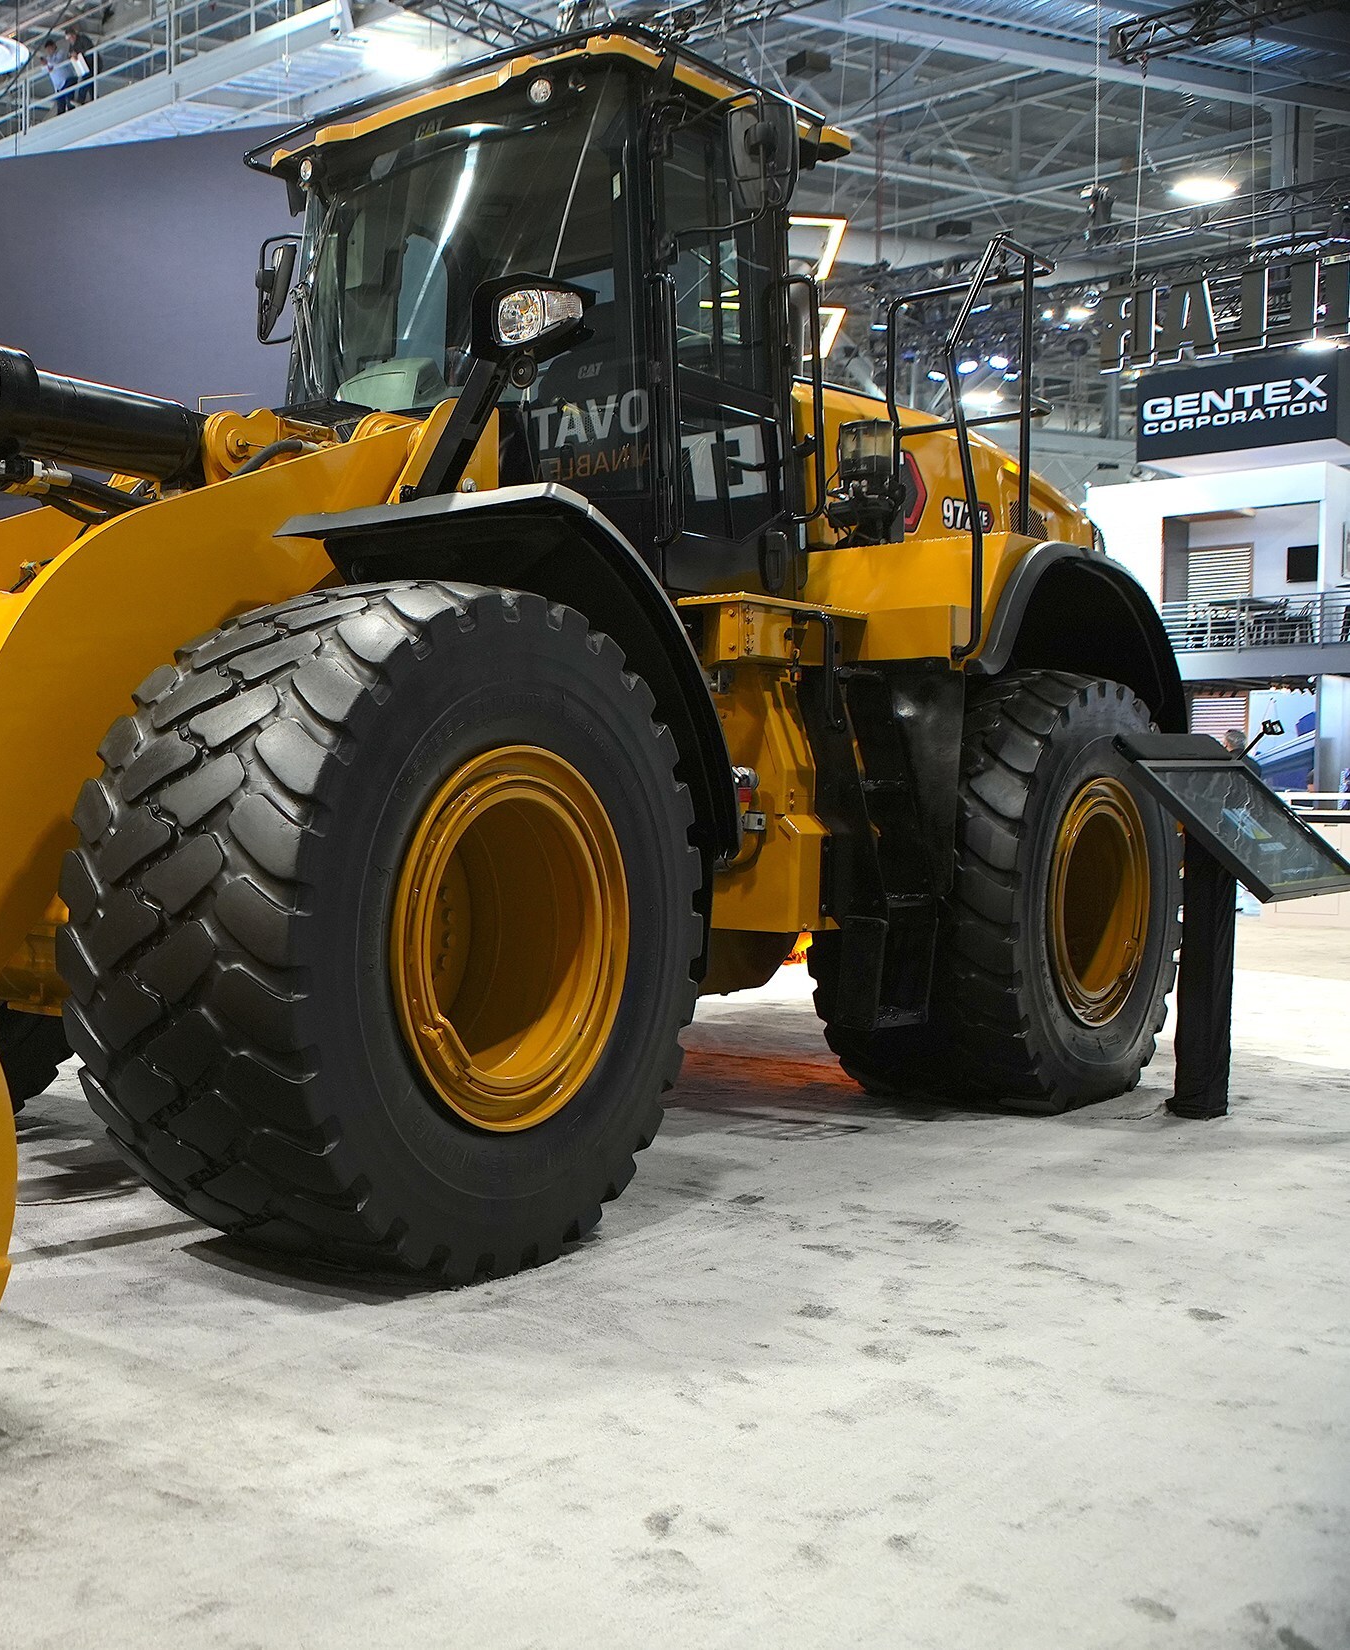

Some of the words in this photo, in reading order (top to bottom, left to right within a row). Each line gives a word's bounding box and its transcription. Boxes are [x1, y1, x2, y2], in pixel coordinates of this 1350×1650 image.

[577, 362, 603, 380] CAT
[1142, 373, 1328, 421] GENTEX
[1143, 399, 1328, 436] CORPORATION
